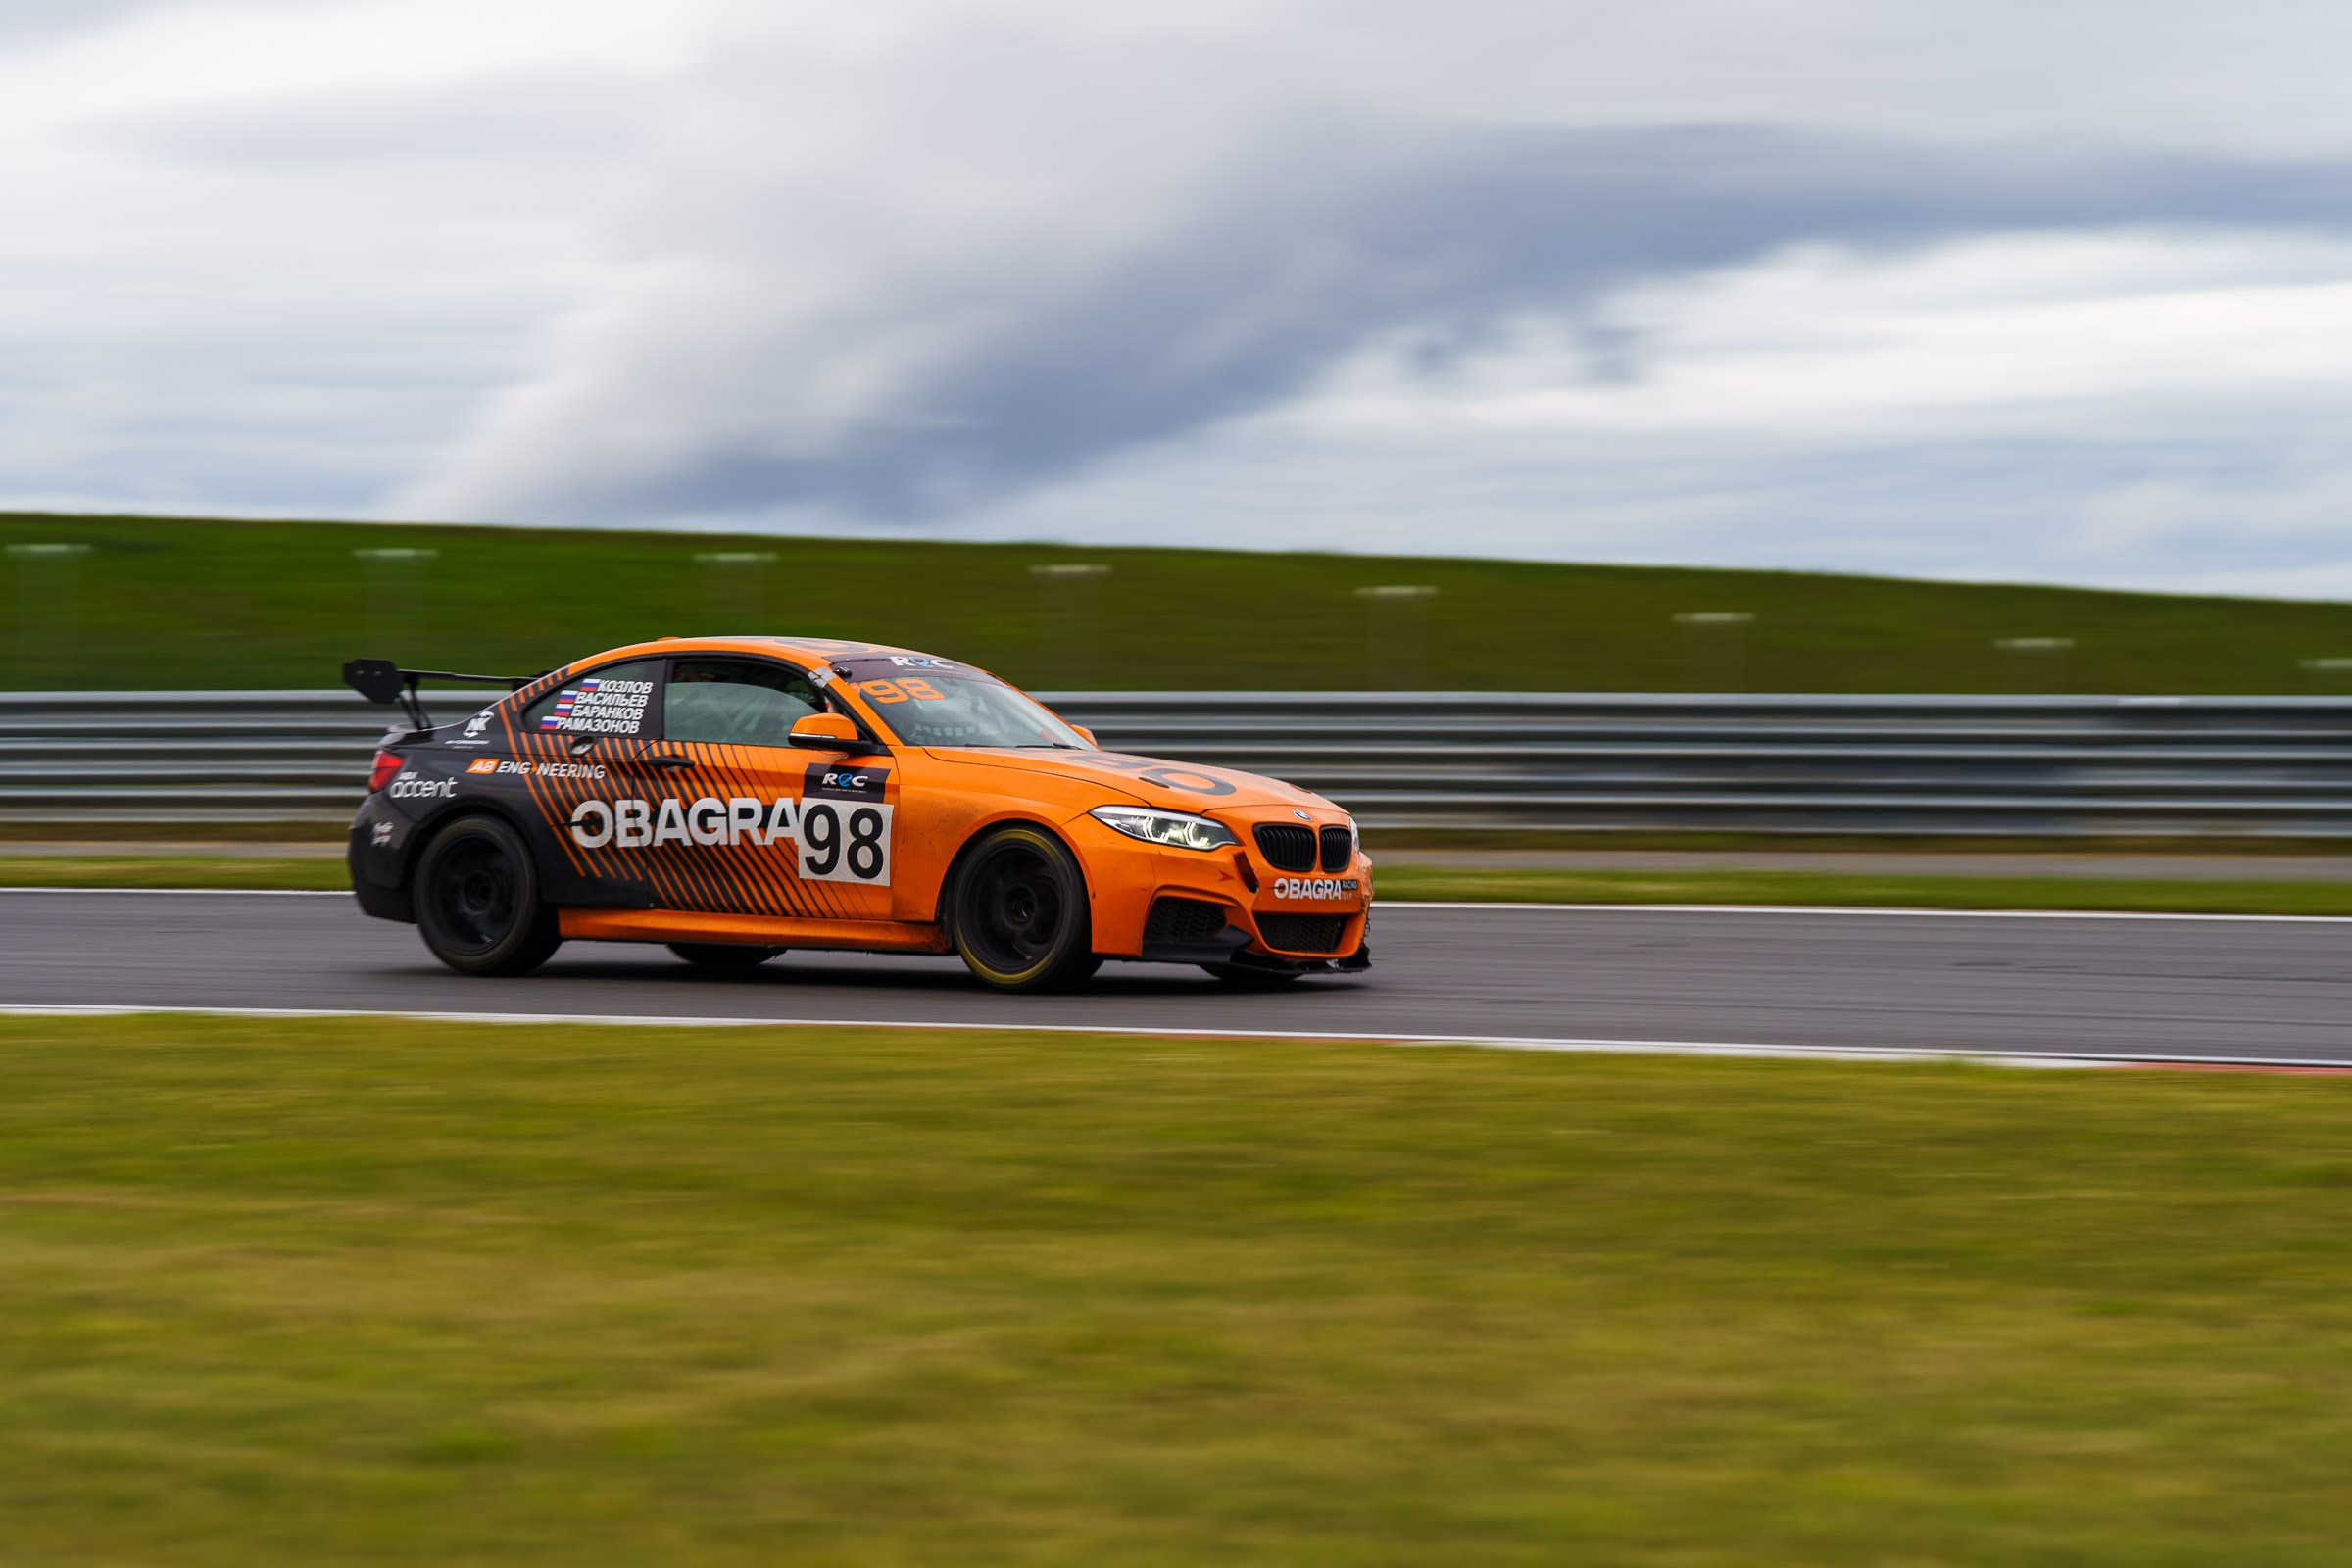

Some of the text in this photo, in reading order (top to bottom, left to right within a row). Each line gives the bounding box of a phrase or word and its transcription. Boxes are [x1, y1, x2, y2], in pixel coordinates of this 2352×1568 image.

[597, 679, 654, 694] КОЗЛОВ
[859, 678, 946, 704] 98
[574, 691, 649, 707] ВАСИЛЬЕВ
[570, 705, 644, 720] БАРАНКОВ
[555, 717, 640, 734] РАМАЗОНОВ
[470, 760, 496, 772] AB
[390, 777, 458, 799] accent
[571, 797, 800, 849] OBAGRA
[803, 804, 884, 880] 98
[1274, 877, 1342, 900] OBAGRA
